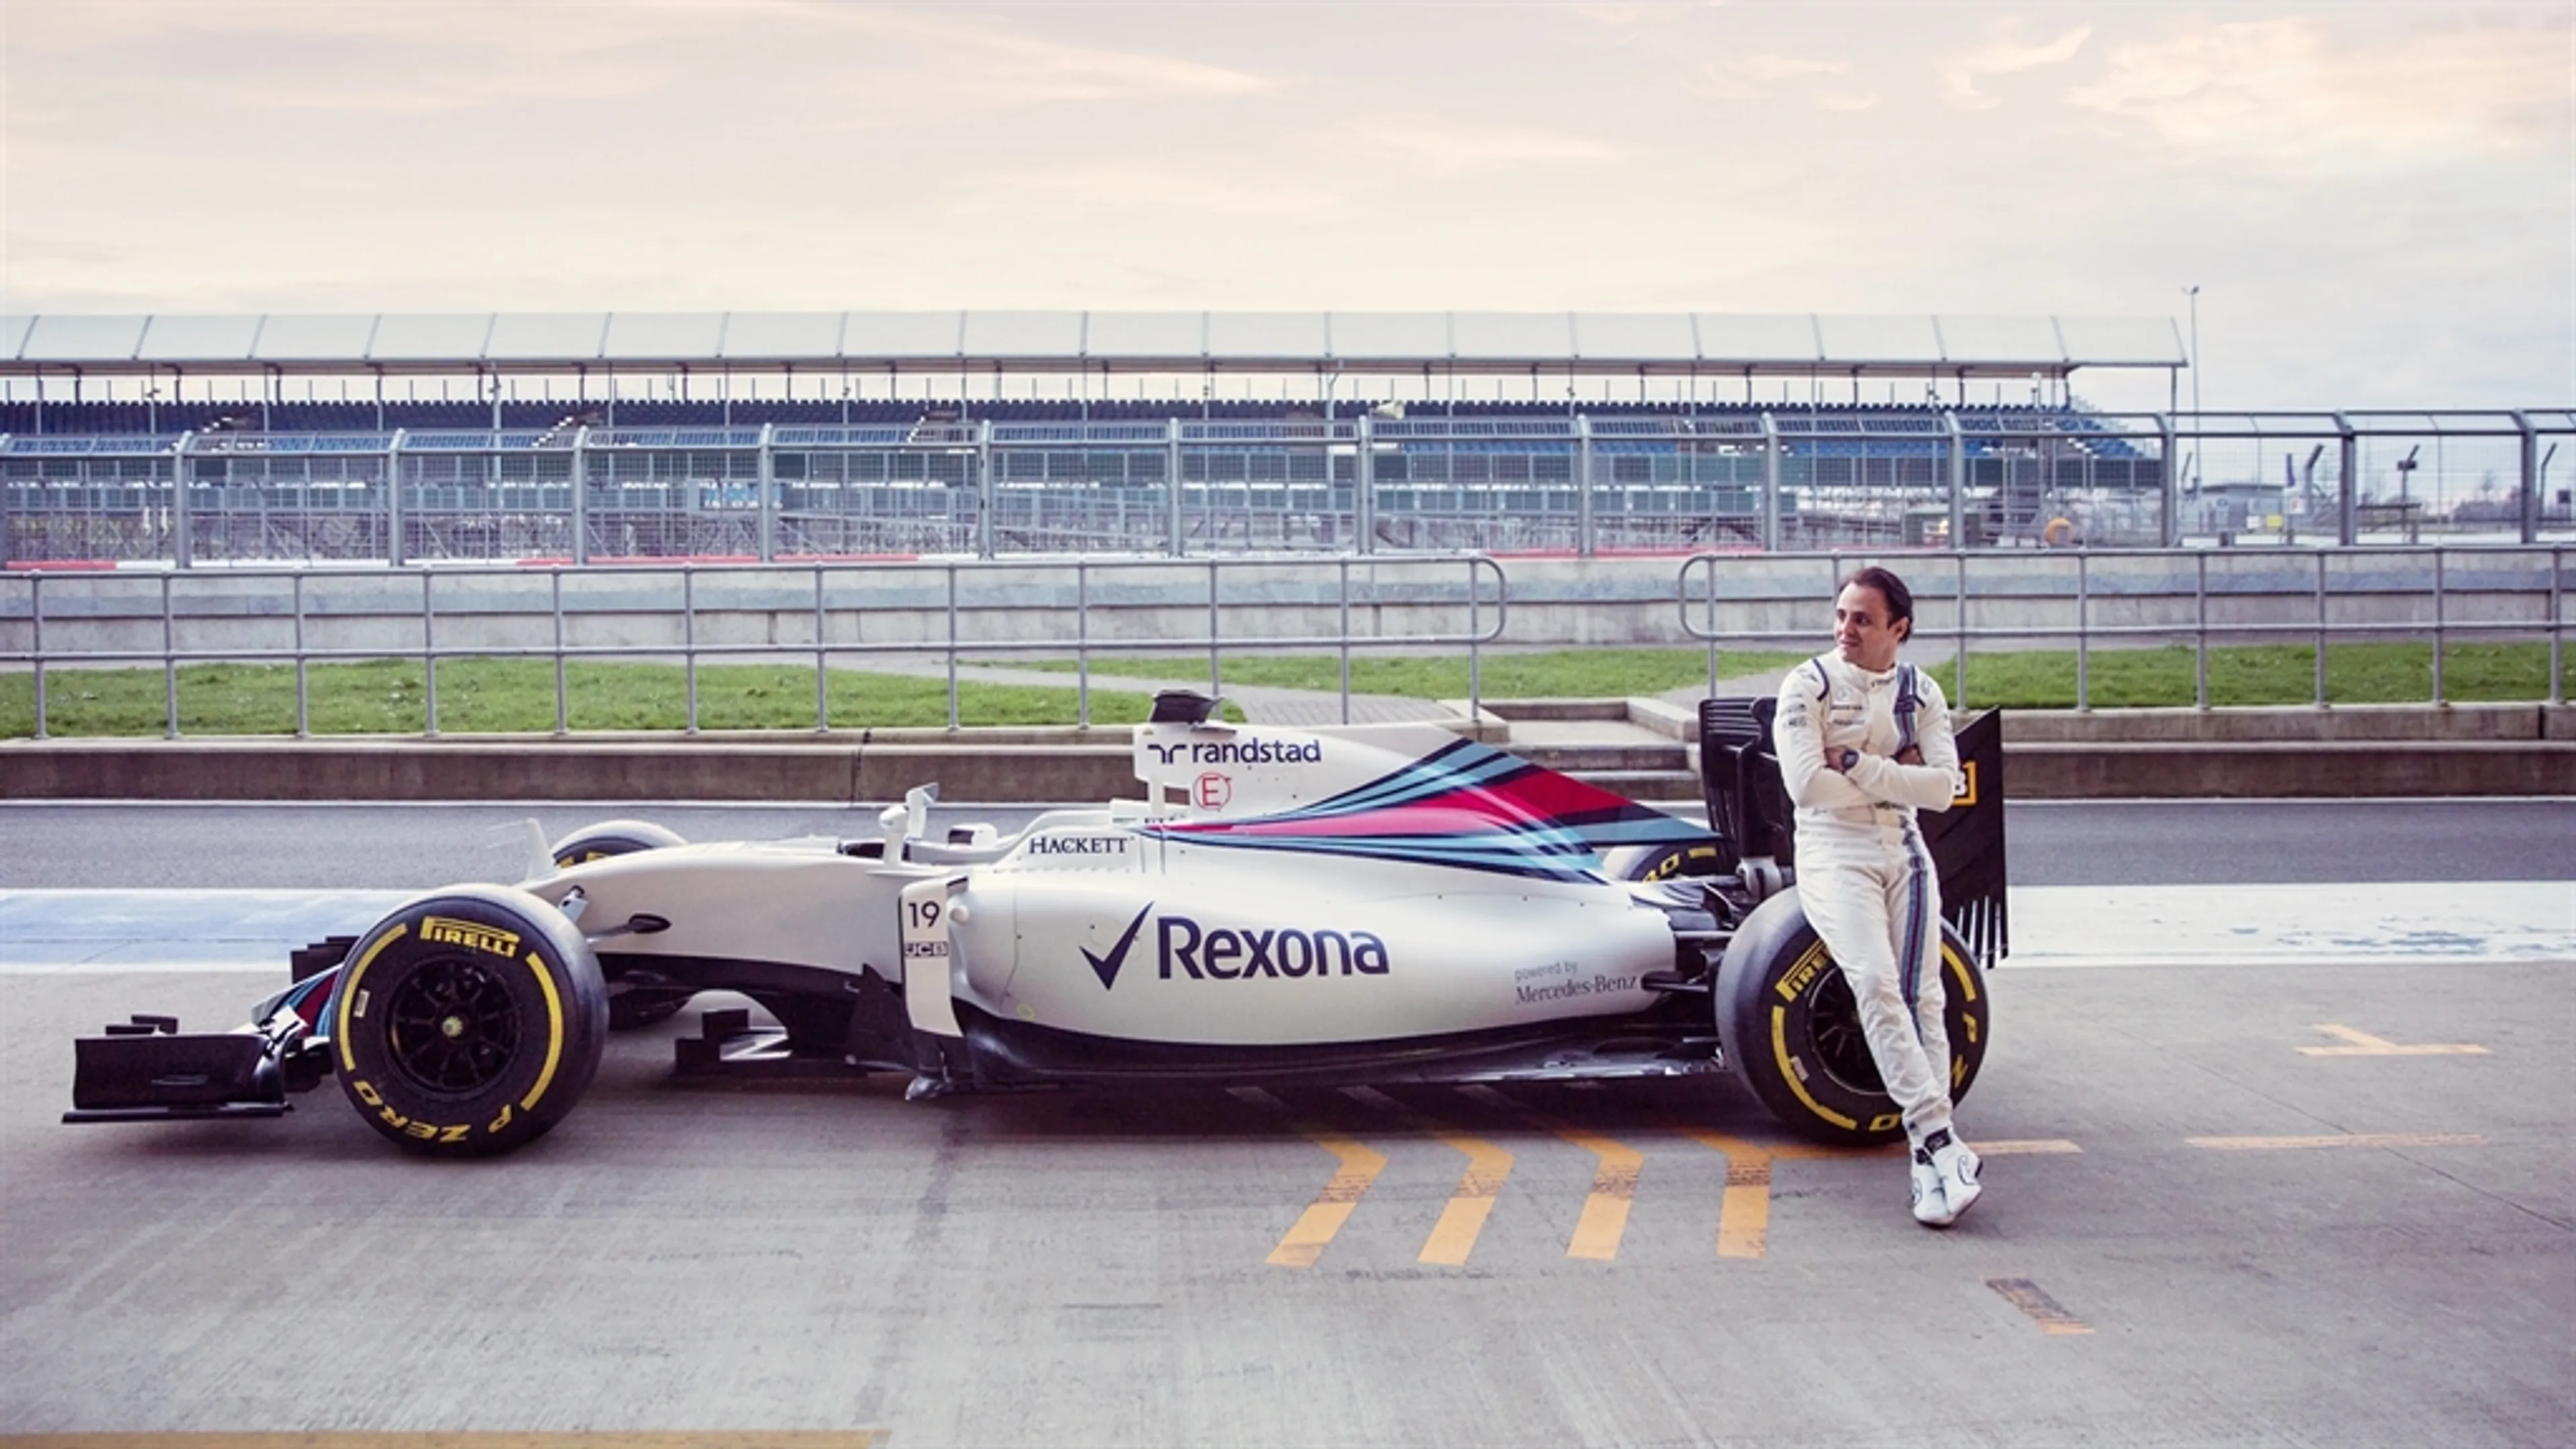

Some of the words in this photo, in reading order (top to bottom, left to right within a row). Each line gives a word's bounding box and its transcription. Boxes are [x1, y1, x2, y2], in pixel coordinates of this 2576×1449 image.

[1192, 737, 1322, 763] randstad
[1029, 837, 1128, 854] HACKETT
[908, 900, 940, 928] 19
[419, 916, 520, 958] PIRELLI
[1157, 916, 1390, 980] Rexona
[1515, 973, 1637, 1004] Mercedes-Benz
[353, 1080, 470, 1142] ZERO
[488, 1104, 513, 1134] P
